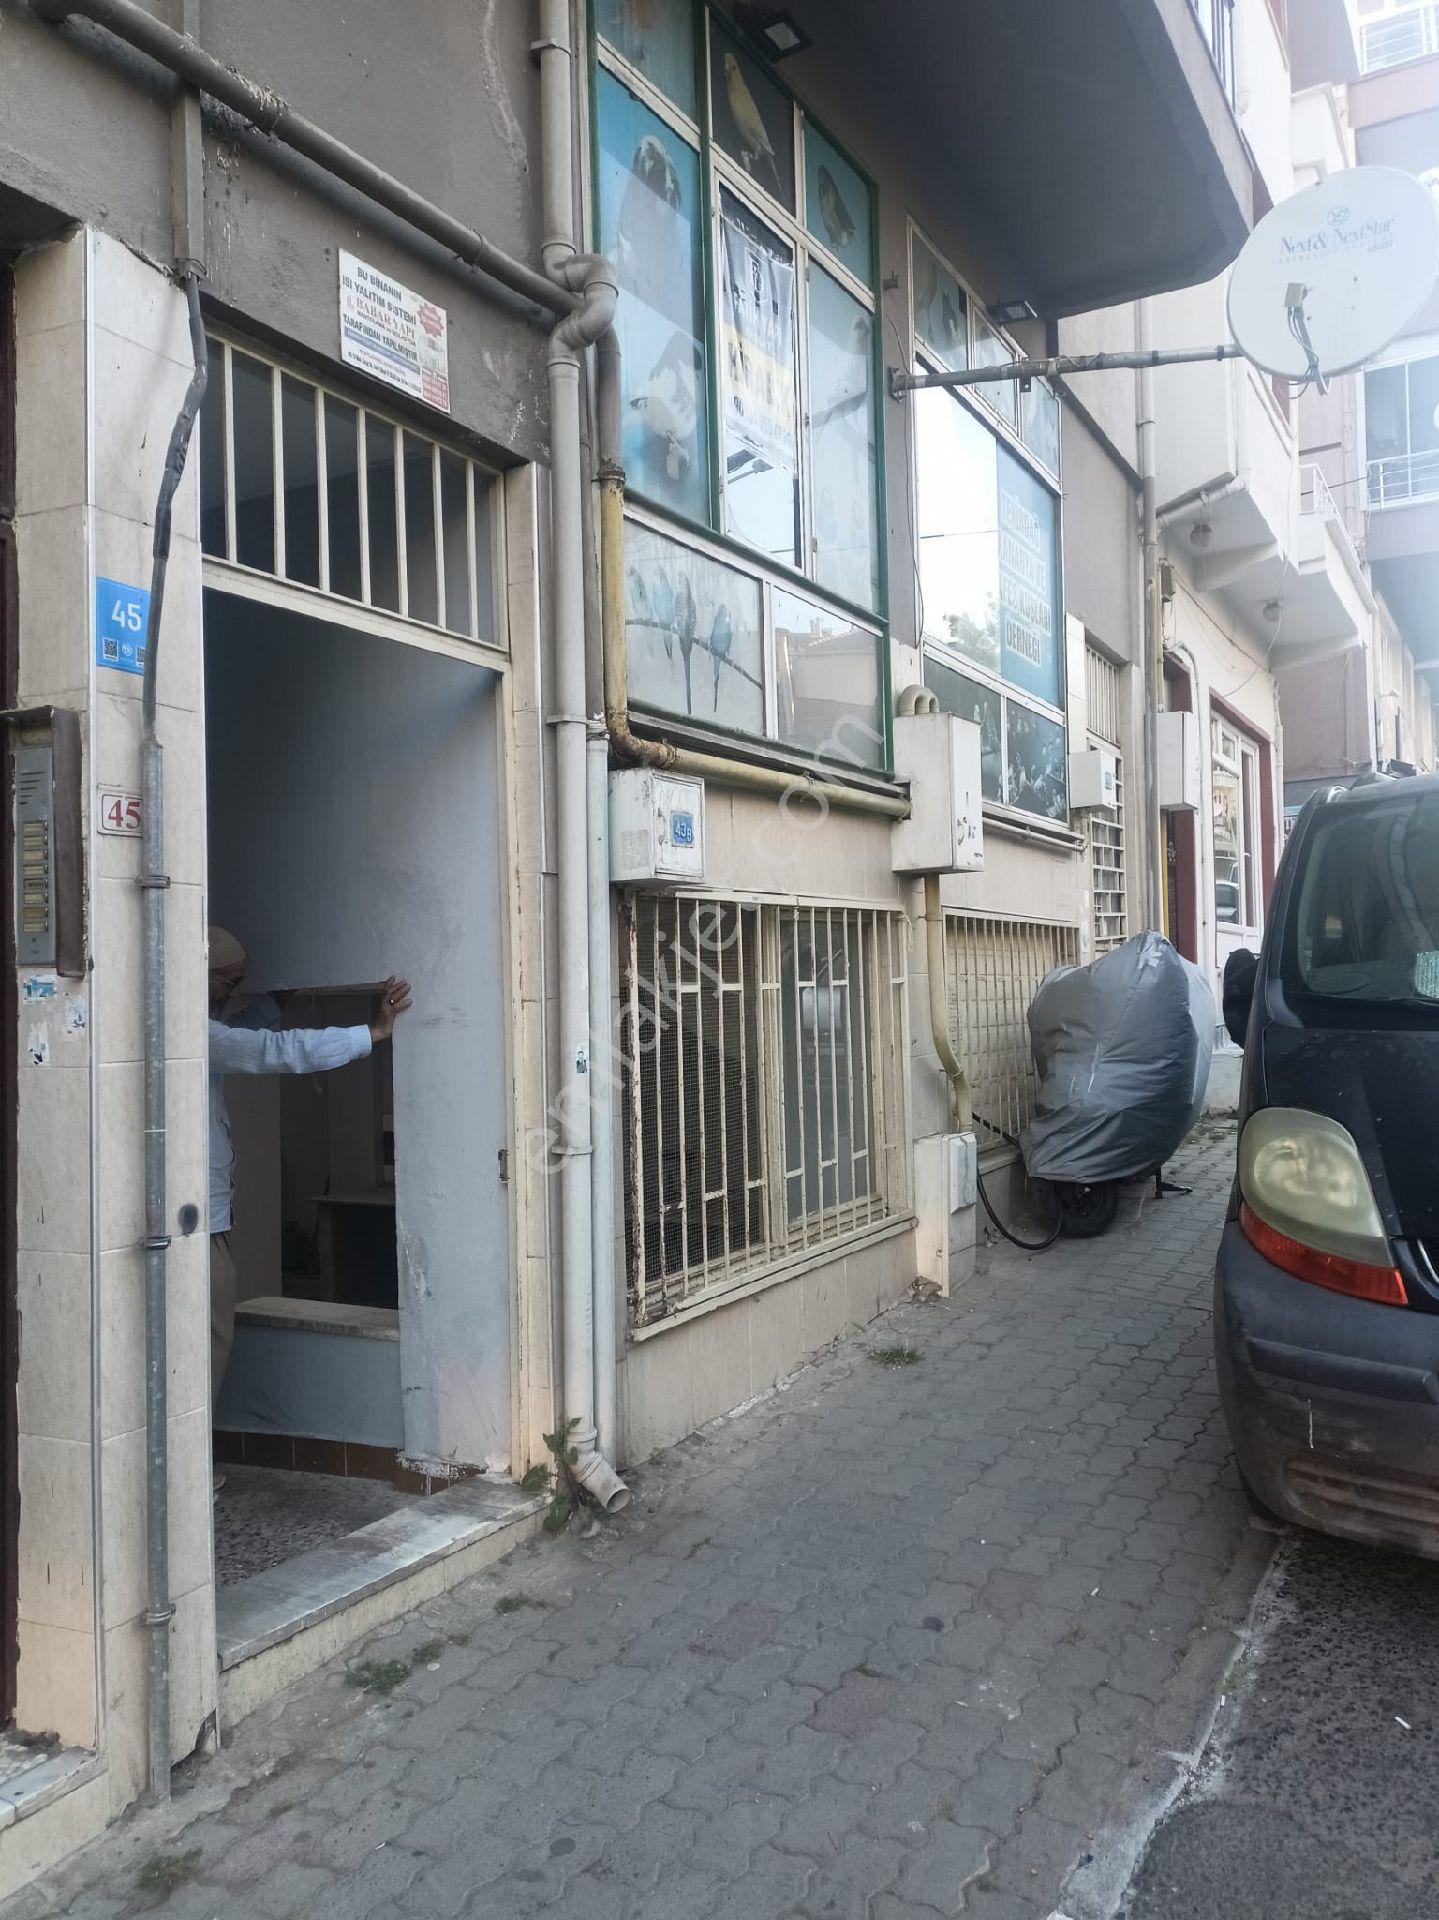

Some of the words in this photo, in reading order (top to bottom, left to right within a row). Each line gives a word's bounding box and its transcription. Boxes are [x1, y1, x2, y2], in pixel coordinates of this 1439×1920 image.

[357, 266, 368, 281] BU
[111, 599, 142, 632] 45
[107, 799, 141, 830] 45
